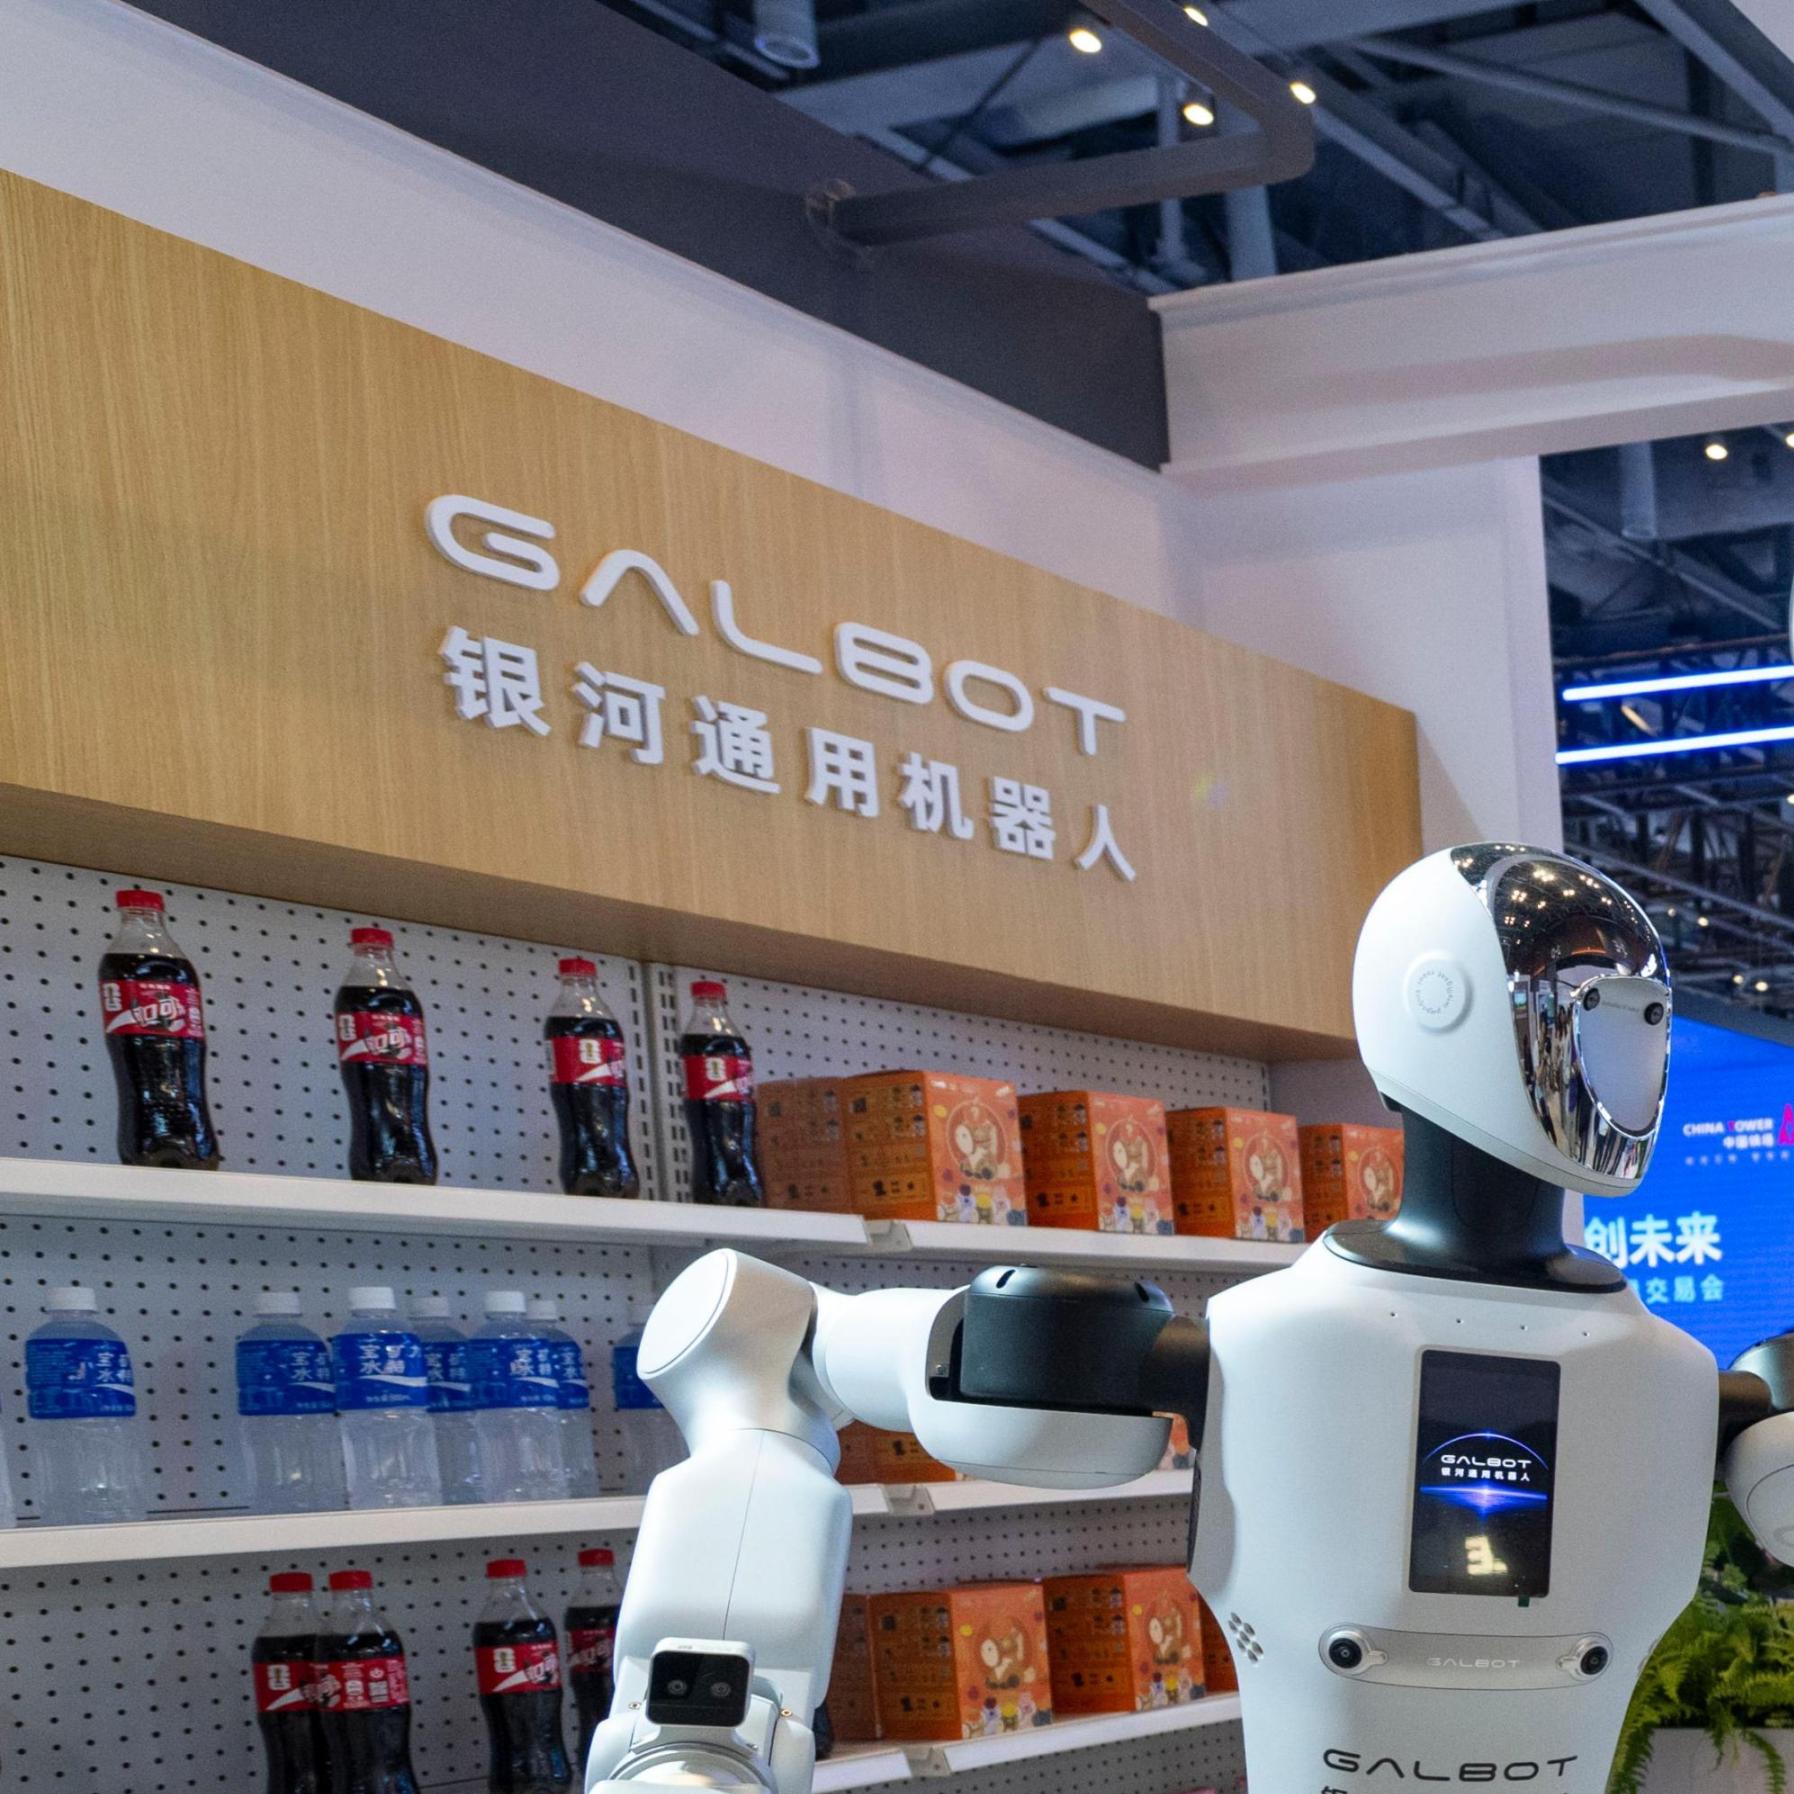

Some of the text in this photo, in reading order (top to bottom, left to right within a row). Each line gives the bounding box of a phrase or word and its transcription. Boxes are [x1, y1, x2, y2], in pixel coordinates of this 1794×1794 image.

[424, 493, 1128, 757] GALBOT
[440, 623, 1139, 883] 银河通用机器人
[1683, 1121, 1724, 1137] CHINA
[1584, 1210, 1723, 1269] 创未来
[1628, 1273, 1724, 1304] 交易会
[1440, 1454, 1532, 1469] GALBOT
[1426, 1657, 1521, 1669] GALBOT
[1323, 1748, 1579, 1782] GALBOT
